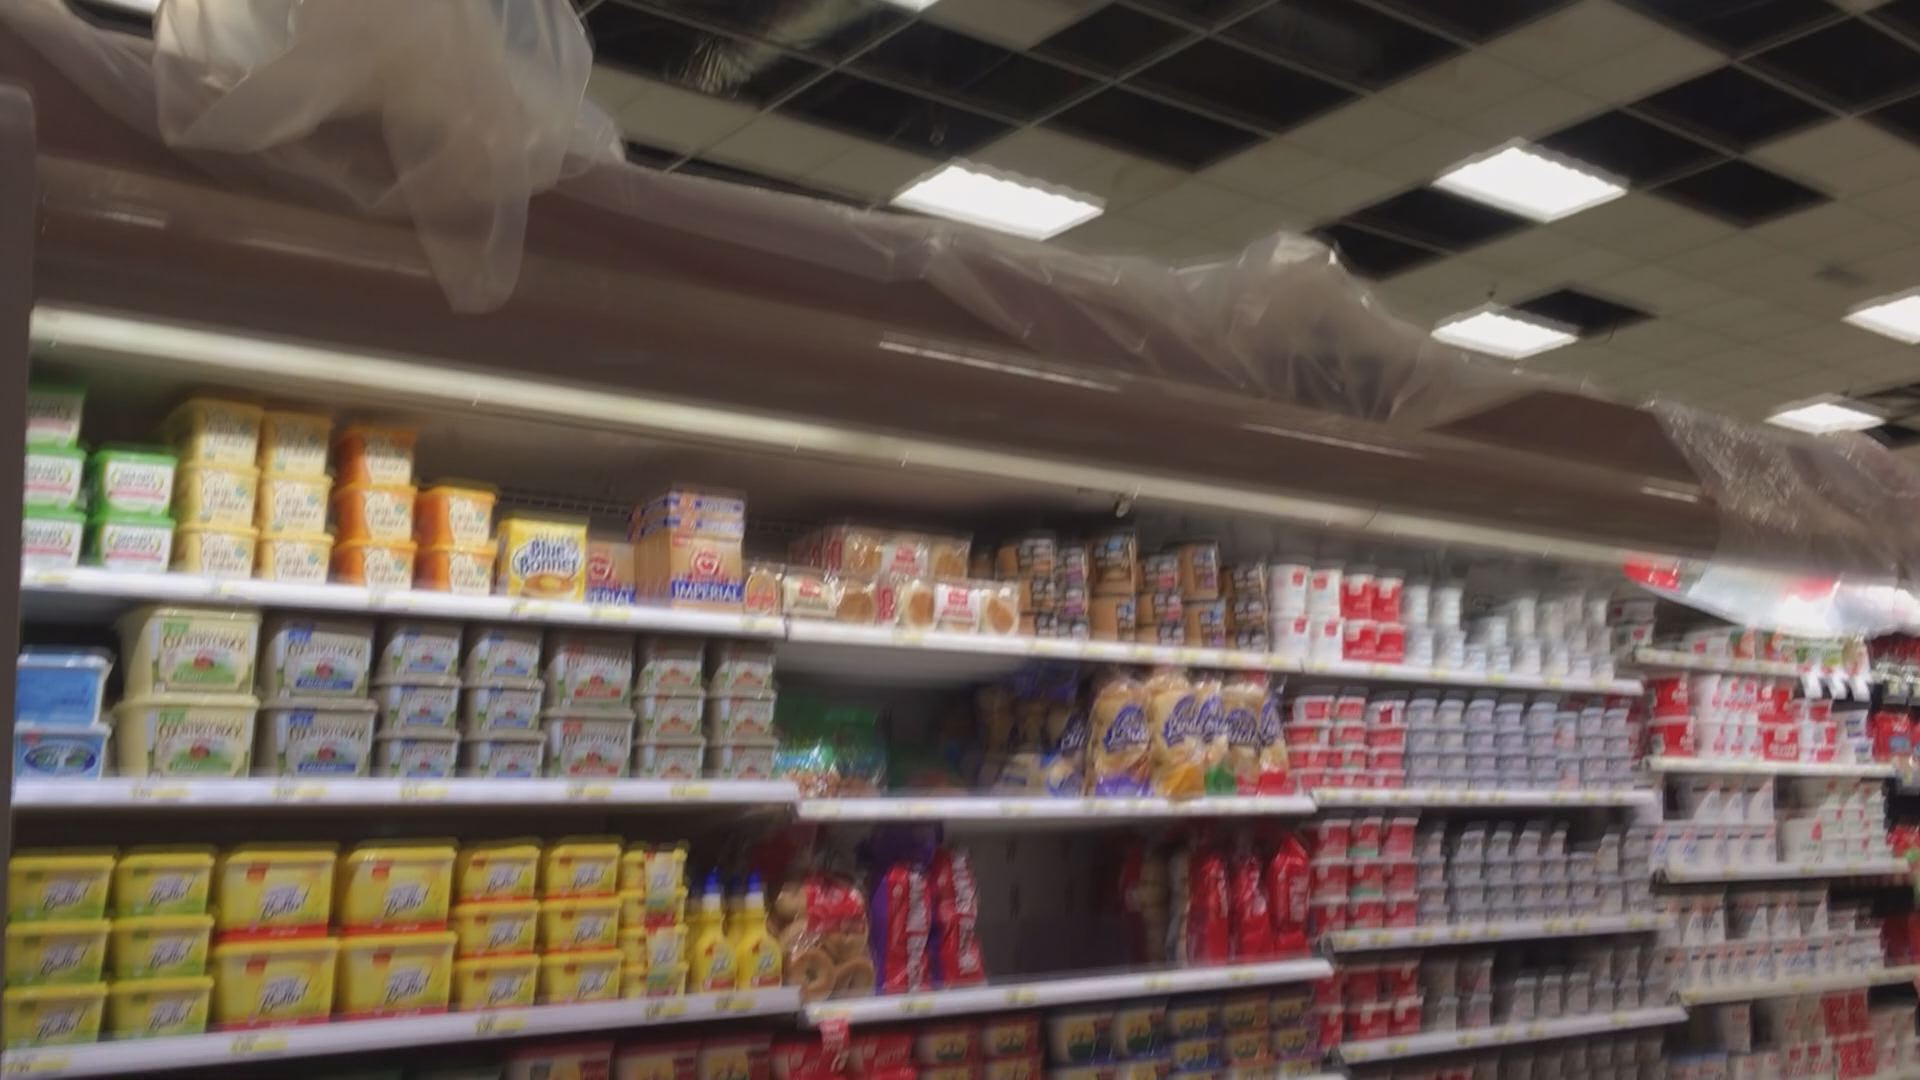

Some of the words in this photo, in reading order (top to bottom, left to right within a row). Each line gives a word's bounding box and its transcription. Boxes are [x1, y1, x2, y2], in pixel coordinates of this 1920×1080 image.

[530, 536, 568, 558] Blue
[519, 555, 578, 577] Bonnet
[673, 579, 739, 602] IMPERIAL
